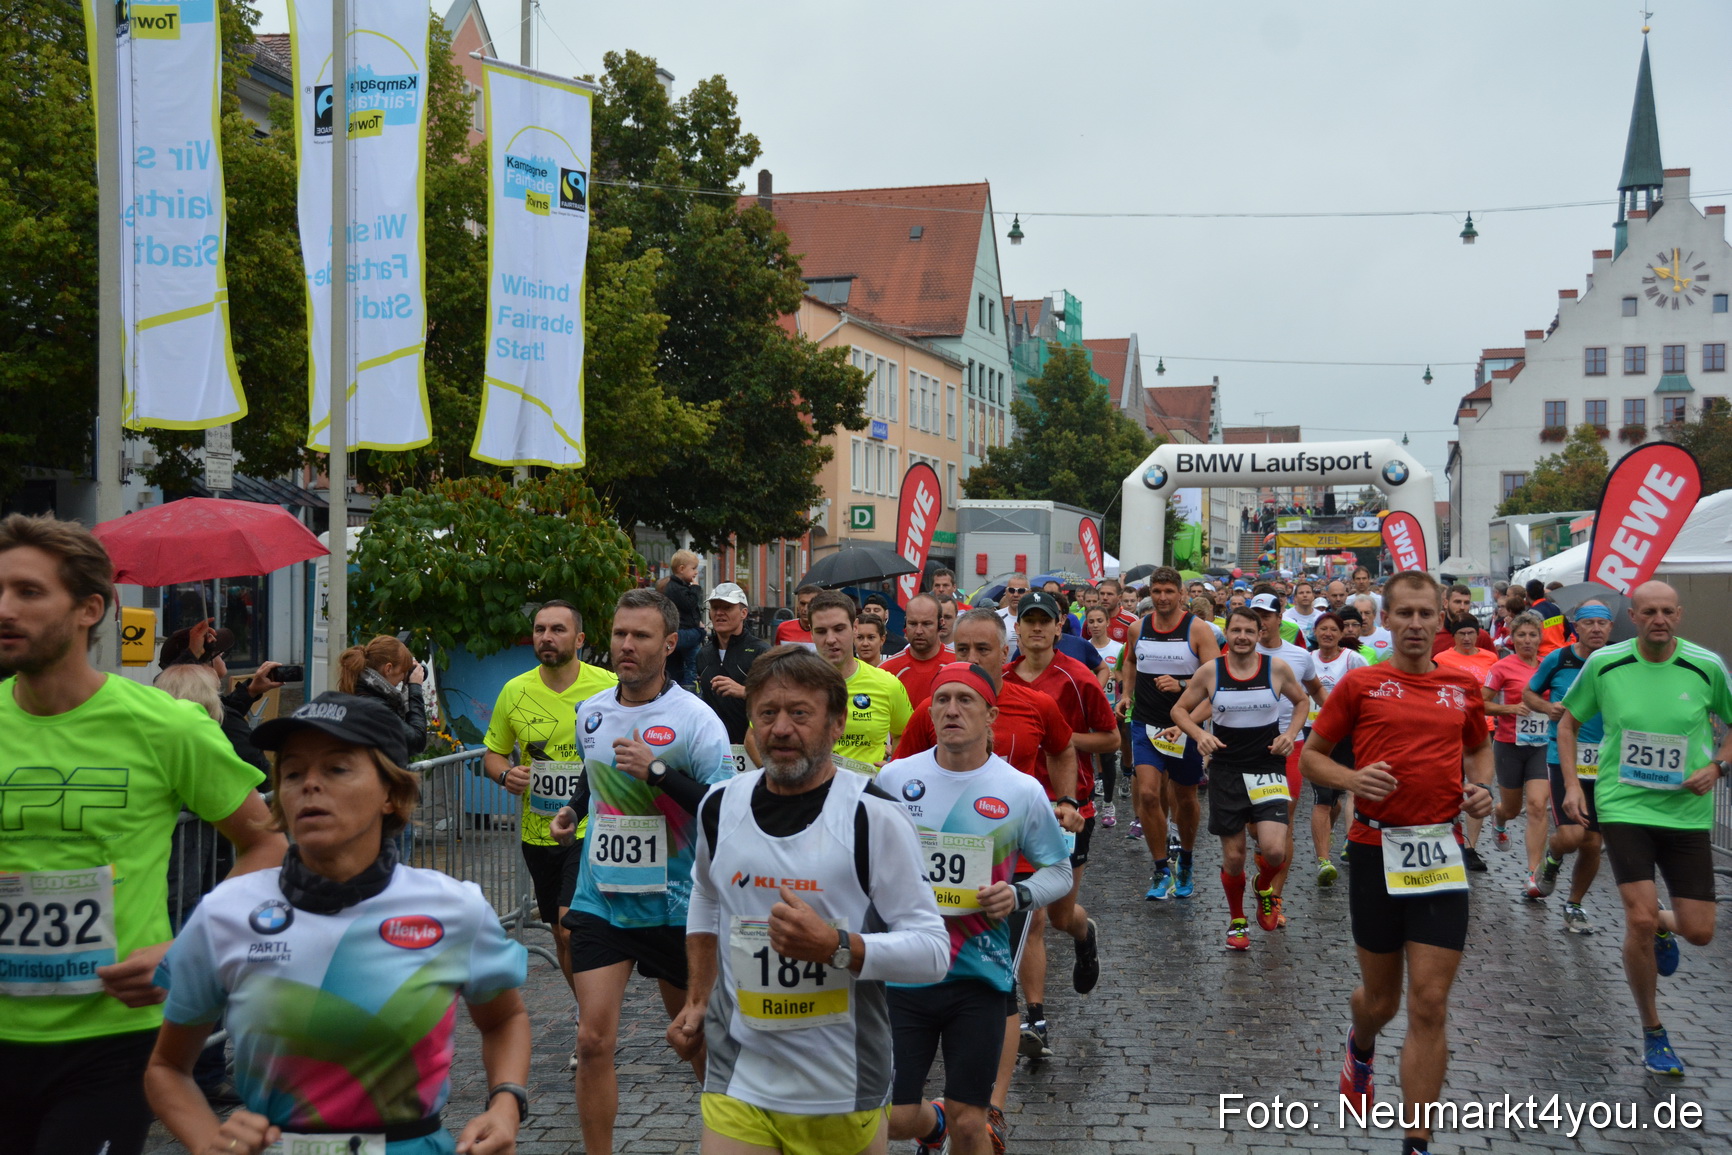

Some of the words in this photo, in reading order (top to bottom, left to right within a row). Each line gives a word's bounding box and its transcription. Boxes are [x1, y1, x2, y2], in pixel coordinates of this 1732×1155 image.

[561, 200, 585, 212] FAIRTRADE
[1176, 453, 1244, 473] BMW
[1250, 451, 1373, 476] Laufsport
[853, 508, 871, 526] D
[1596, 463, 1686, 595] REWE
[899, 480, 934, 600] REWE
[1317, 536, 1341, 545] ZIEL
[1369, 689, 1391, 698] Spitz
[1521, 720, 1549, 733] 251
[646, 730, 672, 741] Hervis
[1626, 744, 1681, 769] 2513
[1633, 770, 1670, 782] Manfred
[533, 773, 580, 797] 2905
[1263, 787, 1283, 796] Flocke
[0, 767, 129, 831] PF
[544, 801, 564, 810] Erich
[908, 804, 923, 813] RTL
[978, 800, 1006, 815] Hervis
[620, 818, 660, 829] BOCK
[596, 833, 656, 864] 3031
[943, 836, 986, 848] BOCK
[1400, 841, 1448, 868] 204
[929, 852, 966, 885] 39
[32, 873, 98, 891] BOCK
[755, 876, 824, 892] KLEBL
[1403, 872, 1450, 886] Christian
[0, 886, 23, 896] Markt
[0, 898, 102, 947] 2232
[387, 920, 437, 940] Hervis
[739, 929, 769, 937] NeuerMar
[249, 942, 292, 954] PARTL
[0, 959, 98, 982] Christopher
[753, 946, 827, 988] 184
[762, 988, 815, 1015] Rainer
